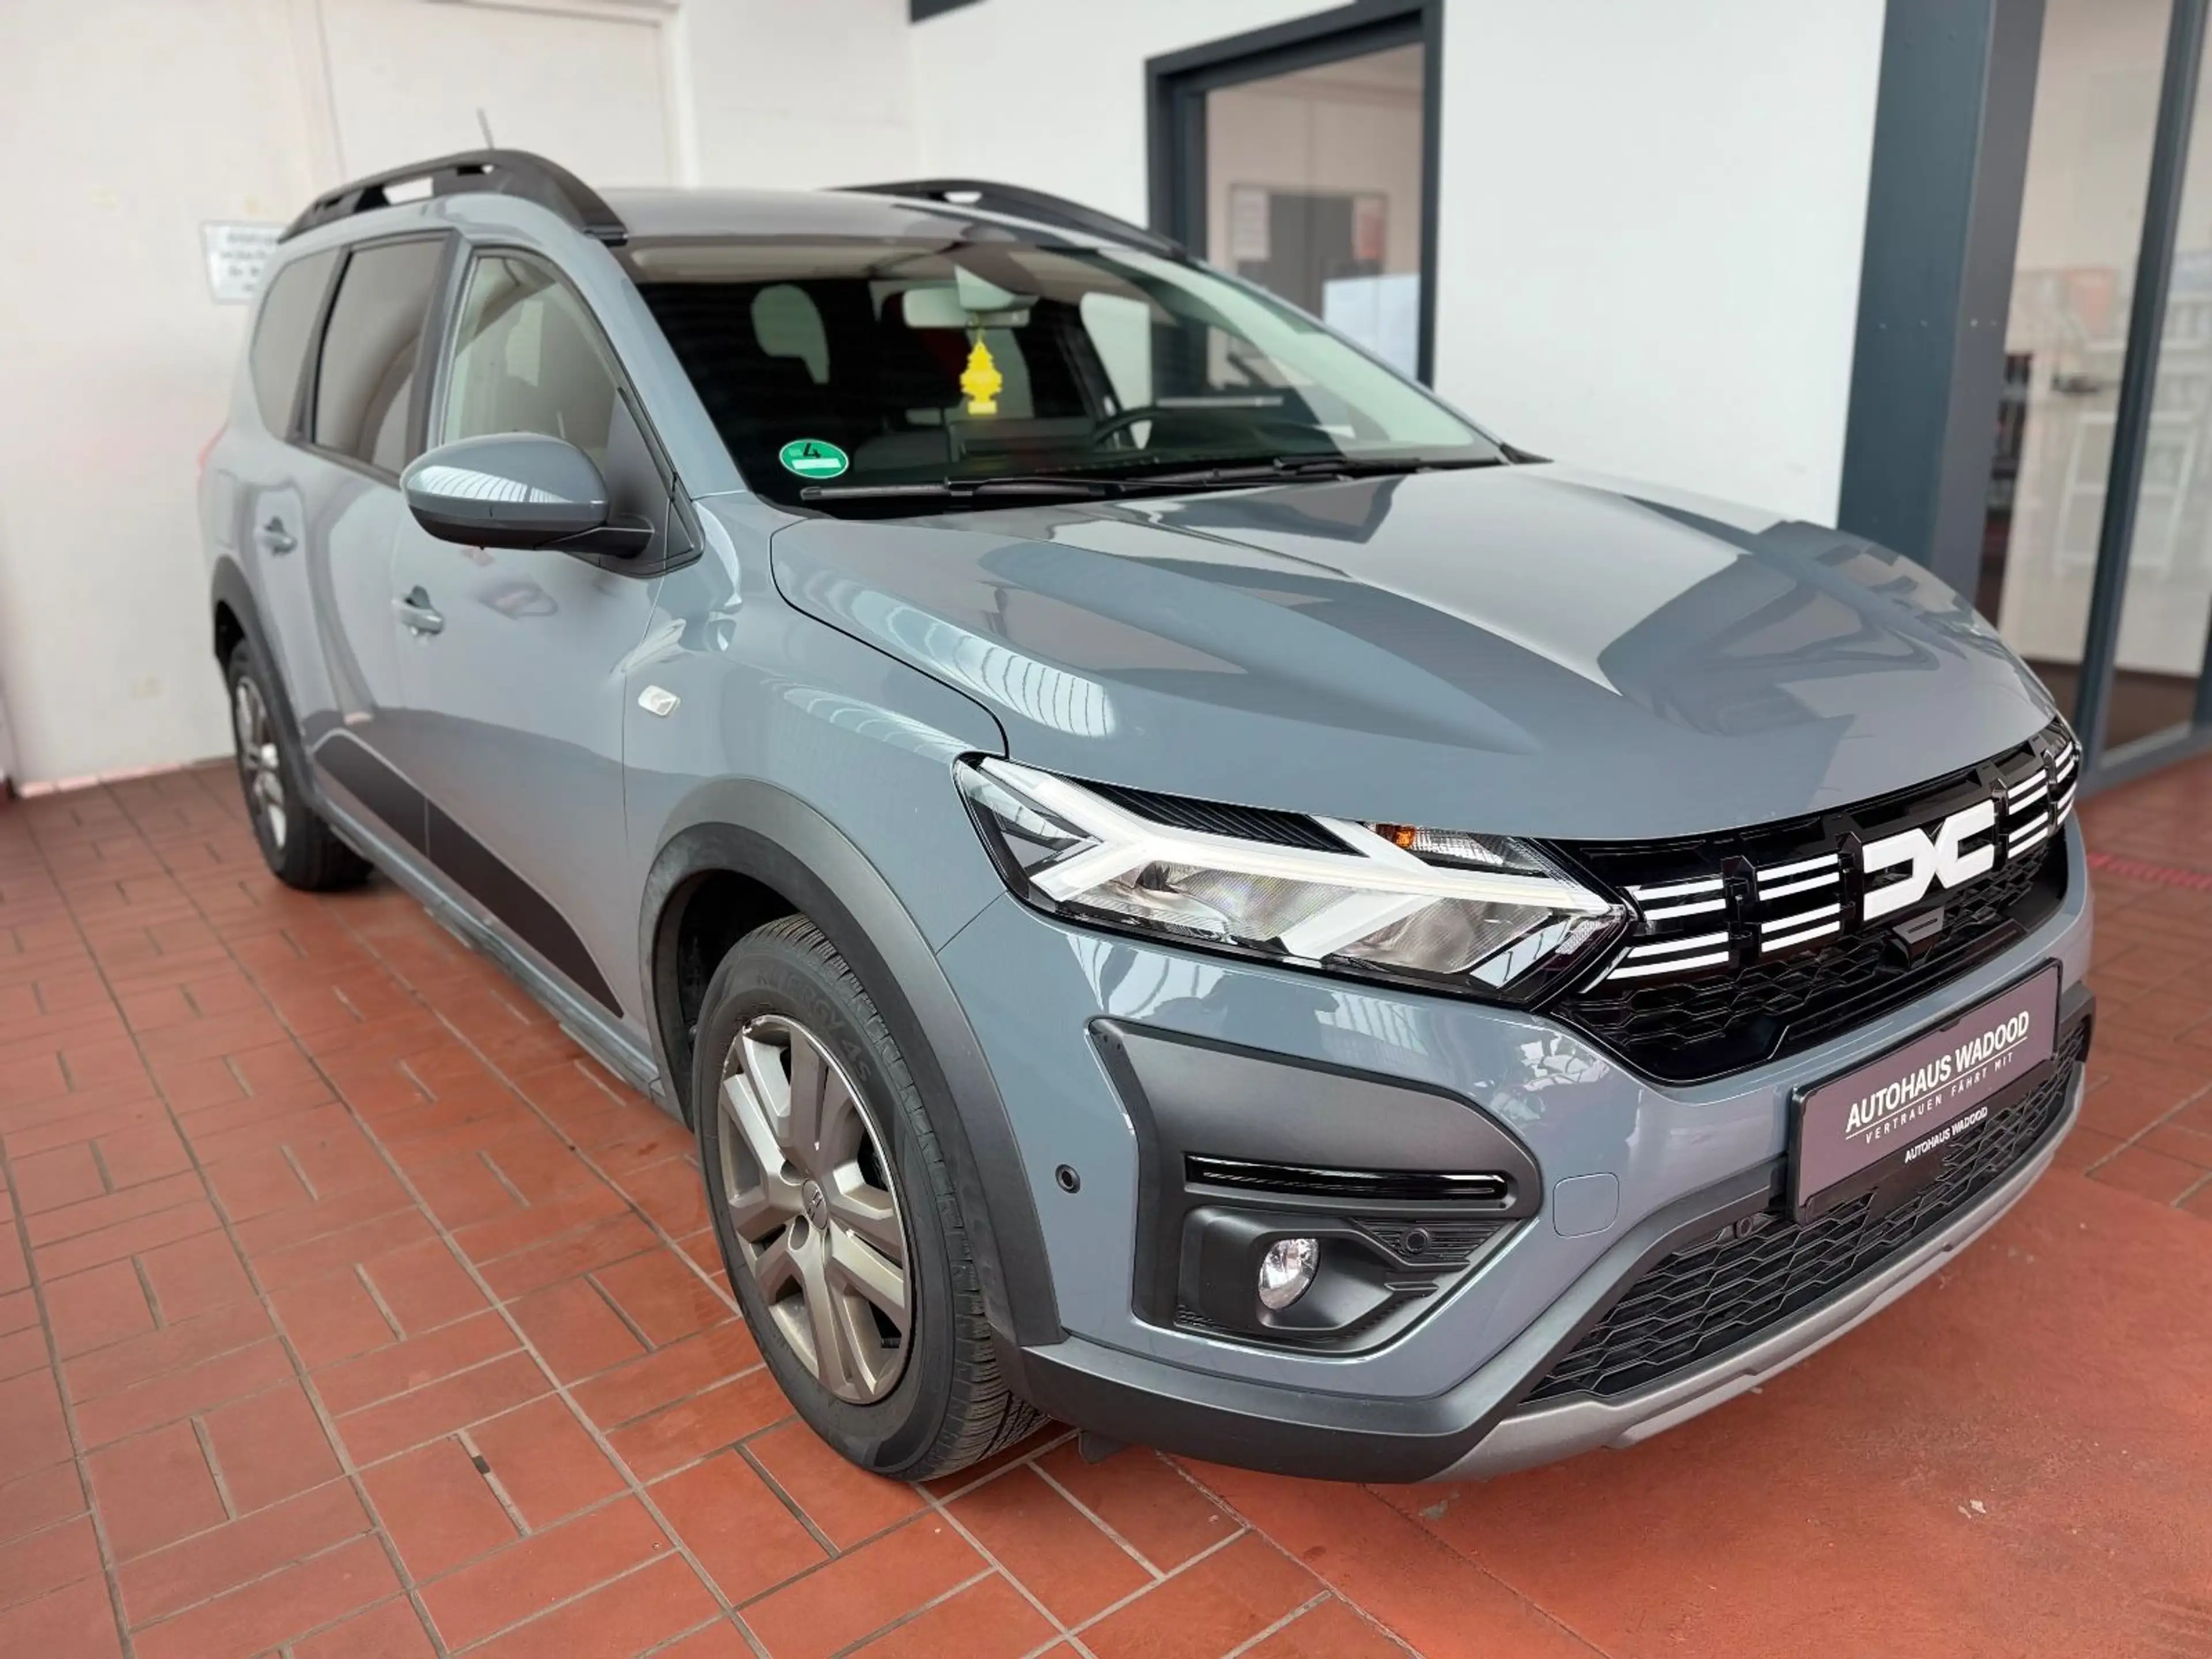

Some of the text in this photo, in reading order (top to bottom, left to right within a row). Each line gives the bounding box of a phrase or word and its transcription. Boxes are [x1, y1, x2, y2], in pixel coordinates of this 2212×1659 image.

[802, 442, 822, 459] 4
[1845, 1010, 2029, 1133] AUTOHAUS WADOOD
[1865, 1093, 1943, 1145] VERTRAUEN
[1994, 1051, 2013, 1072] MIT
[1904, 1105, 1988, 1164] AUTOHAUS WADOOD
